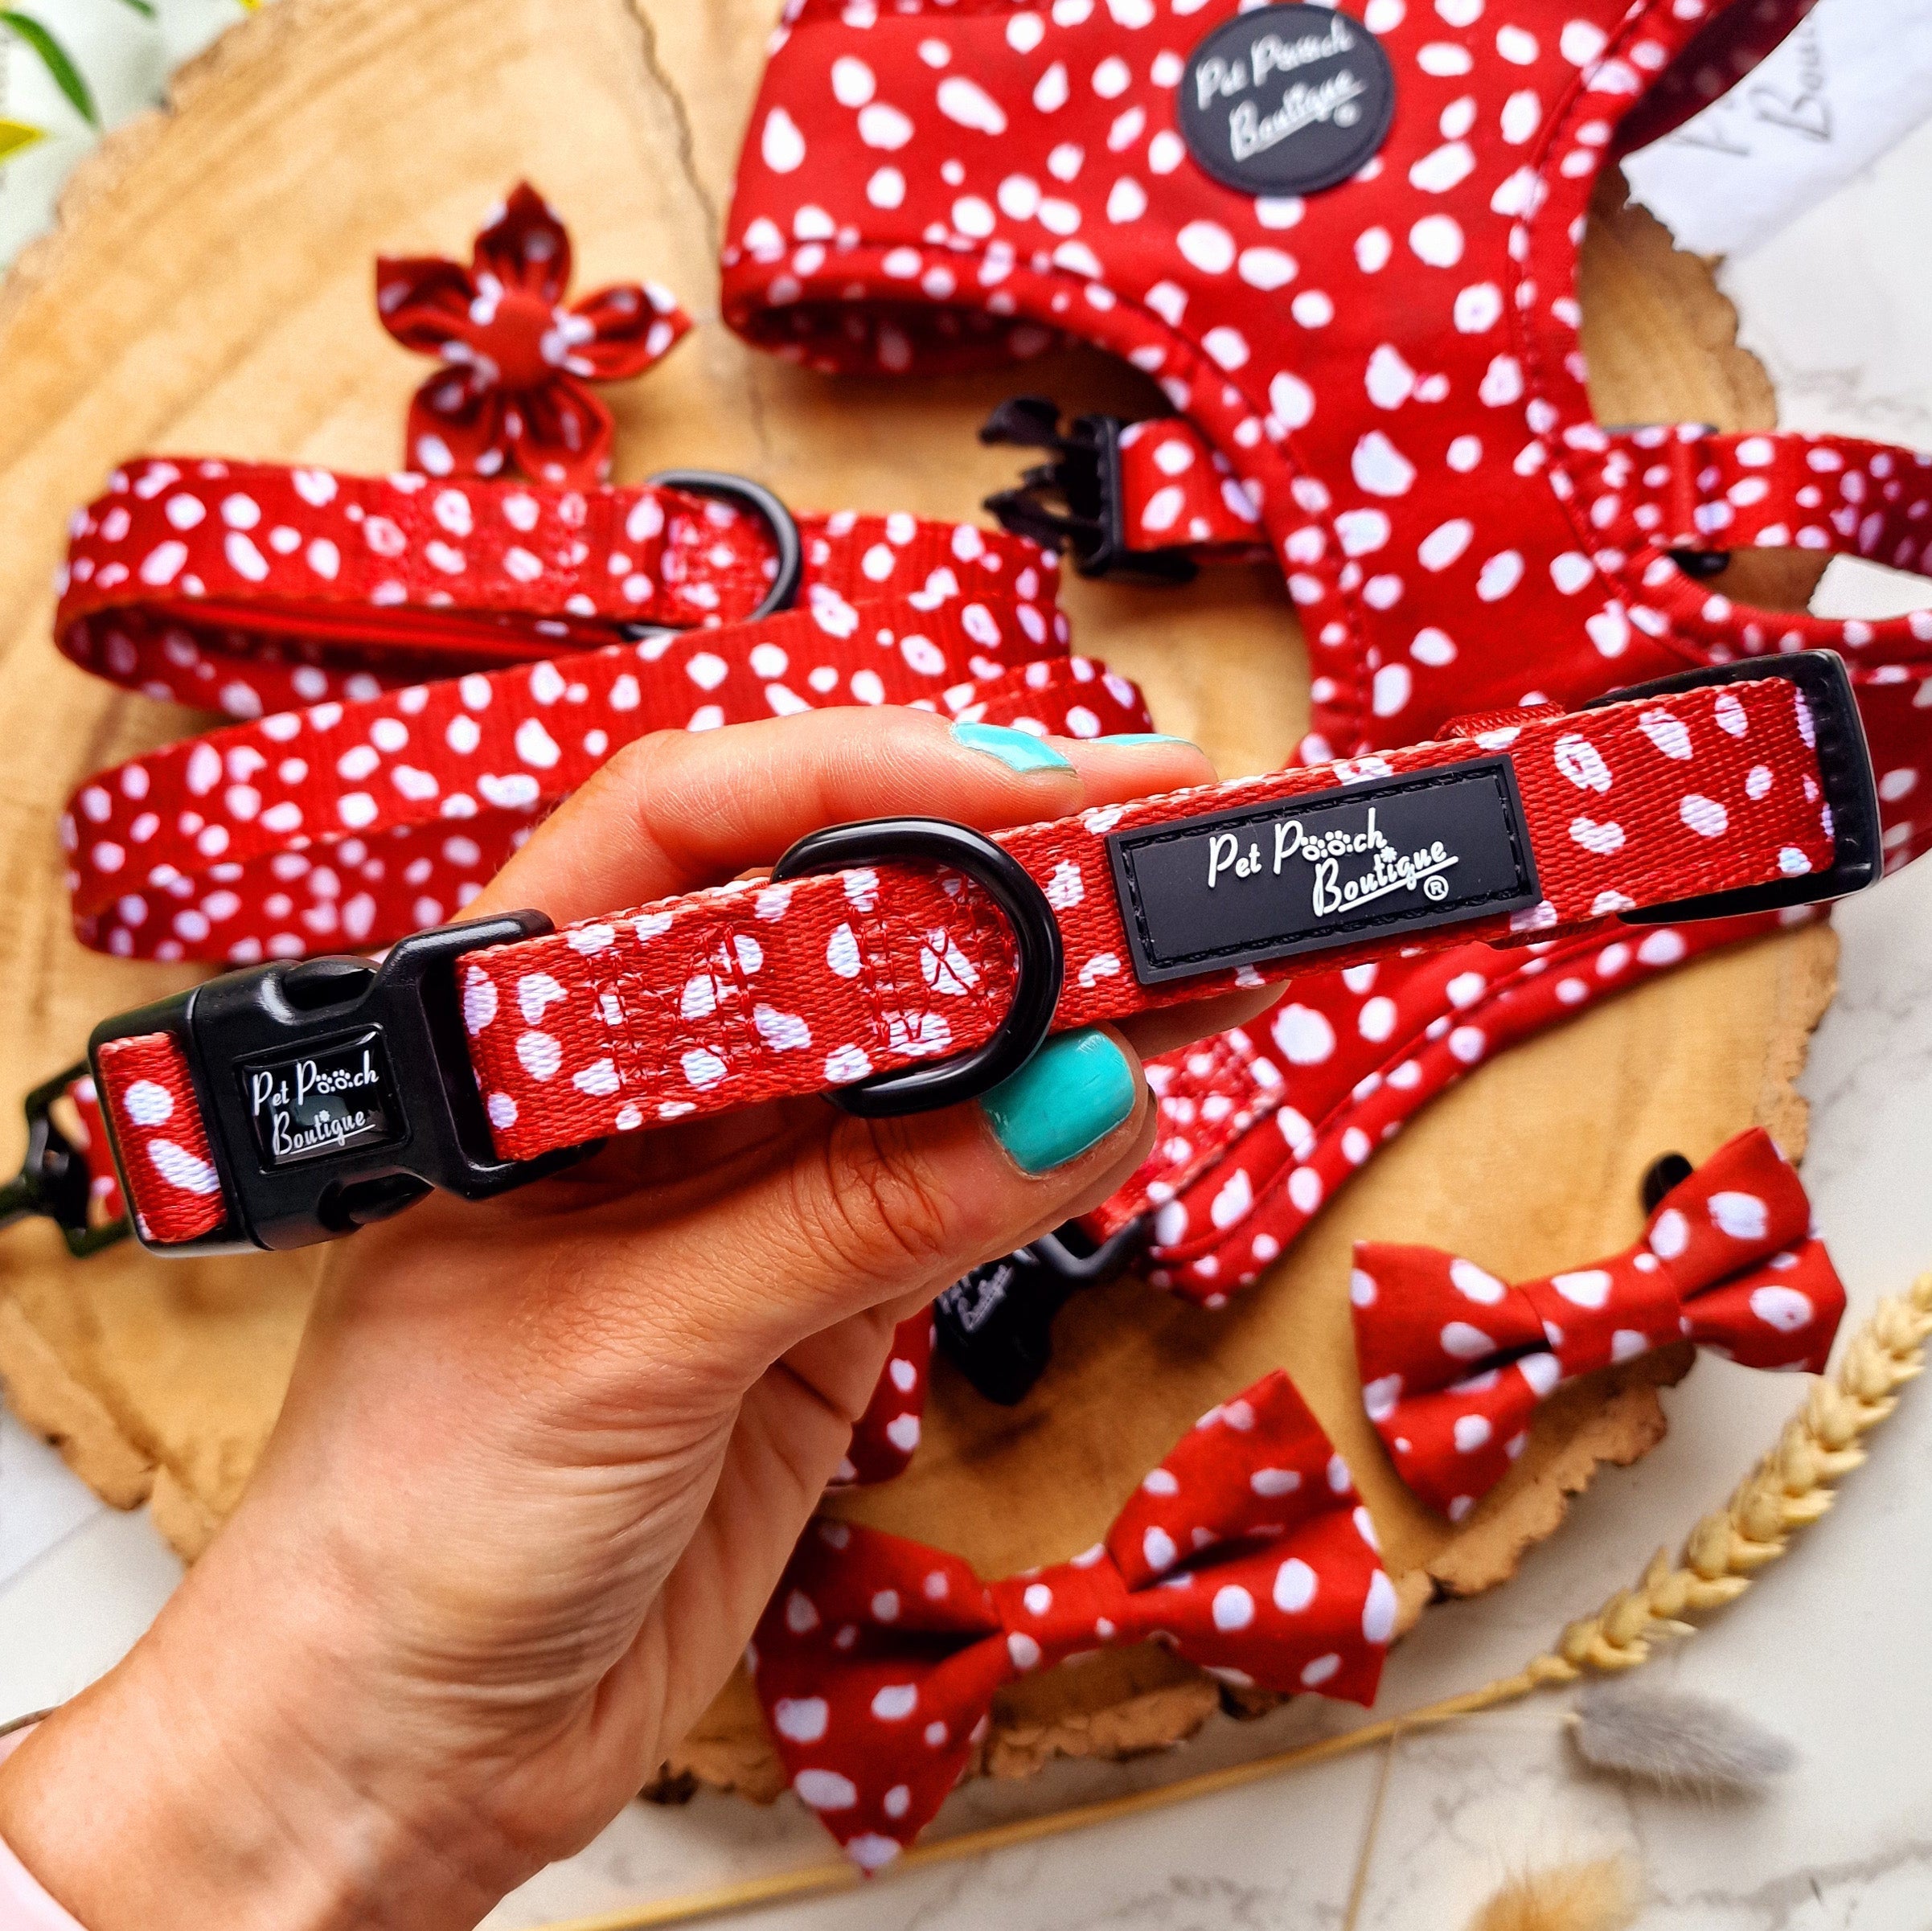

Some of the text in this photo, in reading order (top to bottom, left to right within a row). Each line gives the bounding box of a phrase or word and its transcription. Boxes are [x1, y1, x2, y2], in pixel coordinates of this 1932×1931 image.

[1208, 807, 1388, 888] Pet Pooch
[1312, 840, 1453, 917] Boutique
[252, 1050, 379, 1117] Pet Pooch
[272, 1109, 370, 1156] Boutique
